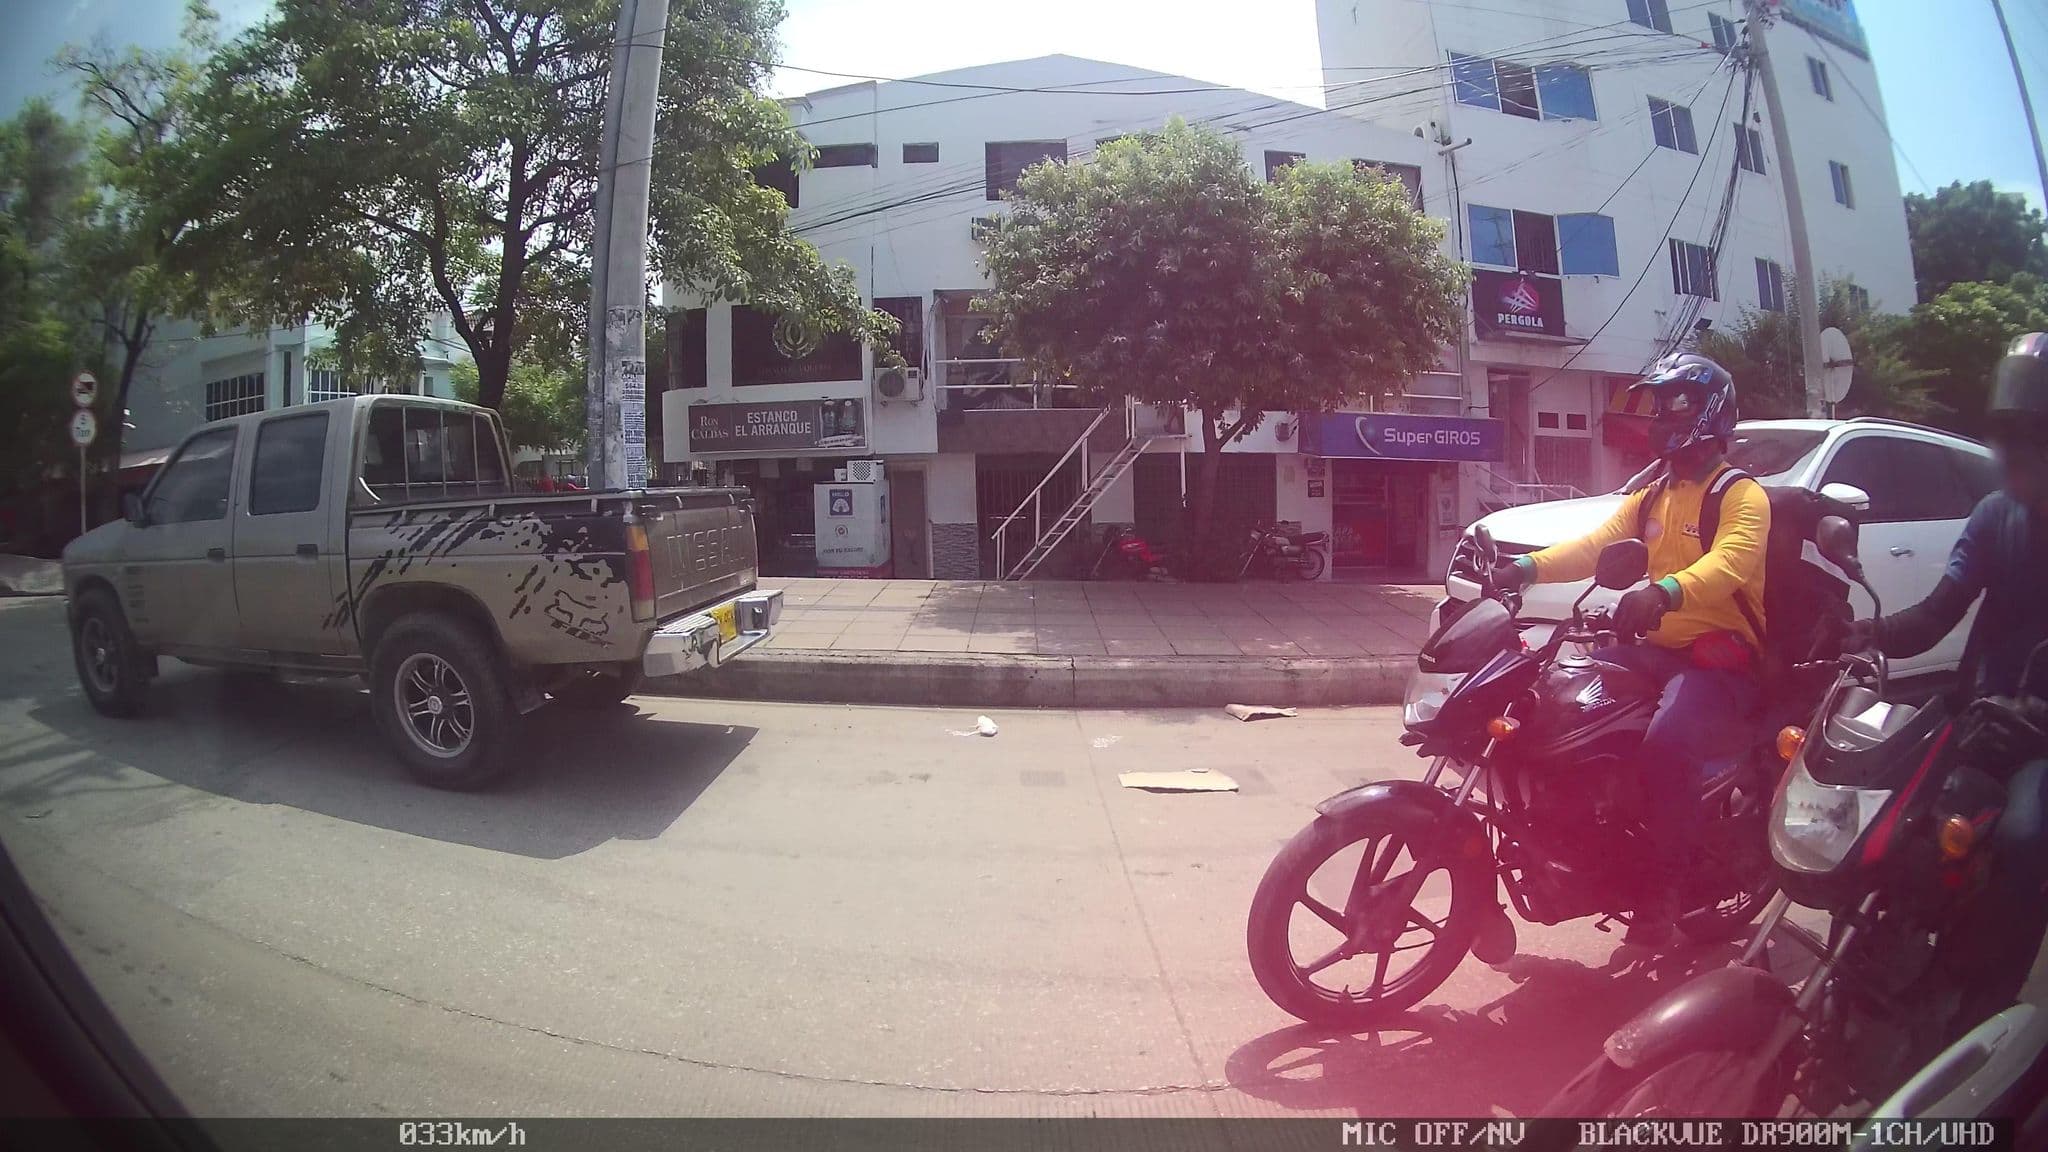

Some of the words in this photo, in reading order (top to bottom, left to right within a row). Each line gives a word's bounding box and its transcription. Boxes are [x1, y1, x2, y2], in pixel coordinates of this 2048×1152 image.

[1497, 313, 1544, 328] PERGOLA
[747, 410, 798, 424] ESTANCO
[735, 424, 748, 437] EL
[751, 422, 812, 437] ARRANQUE
